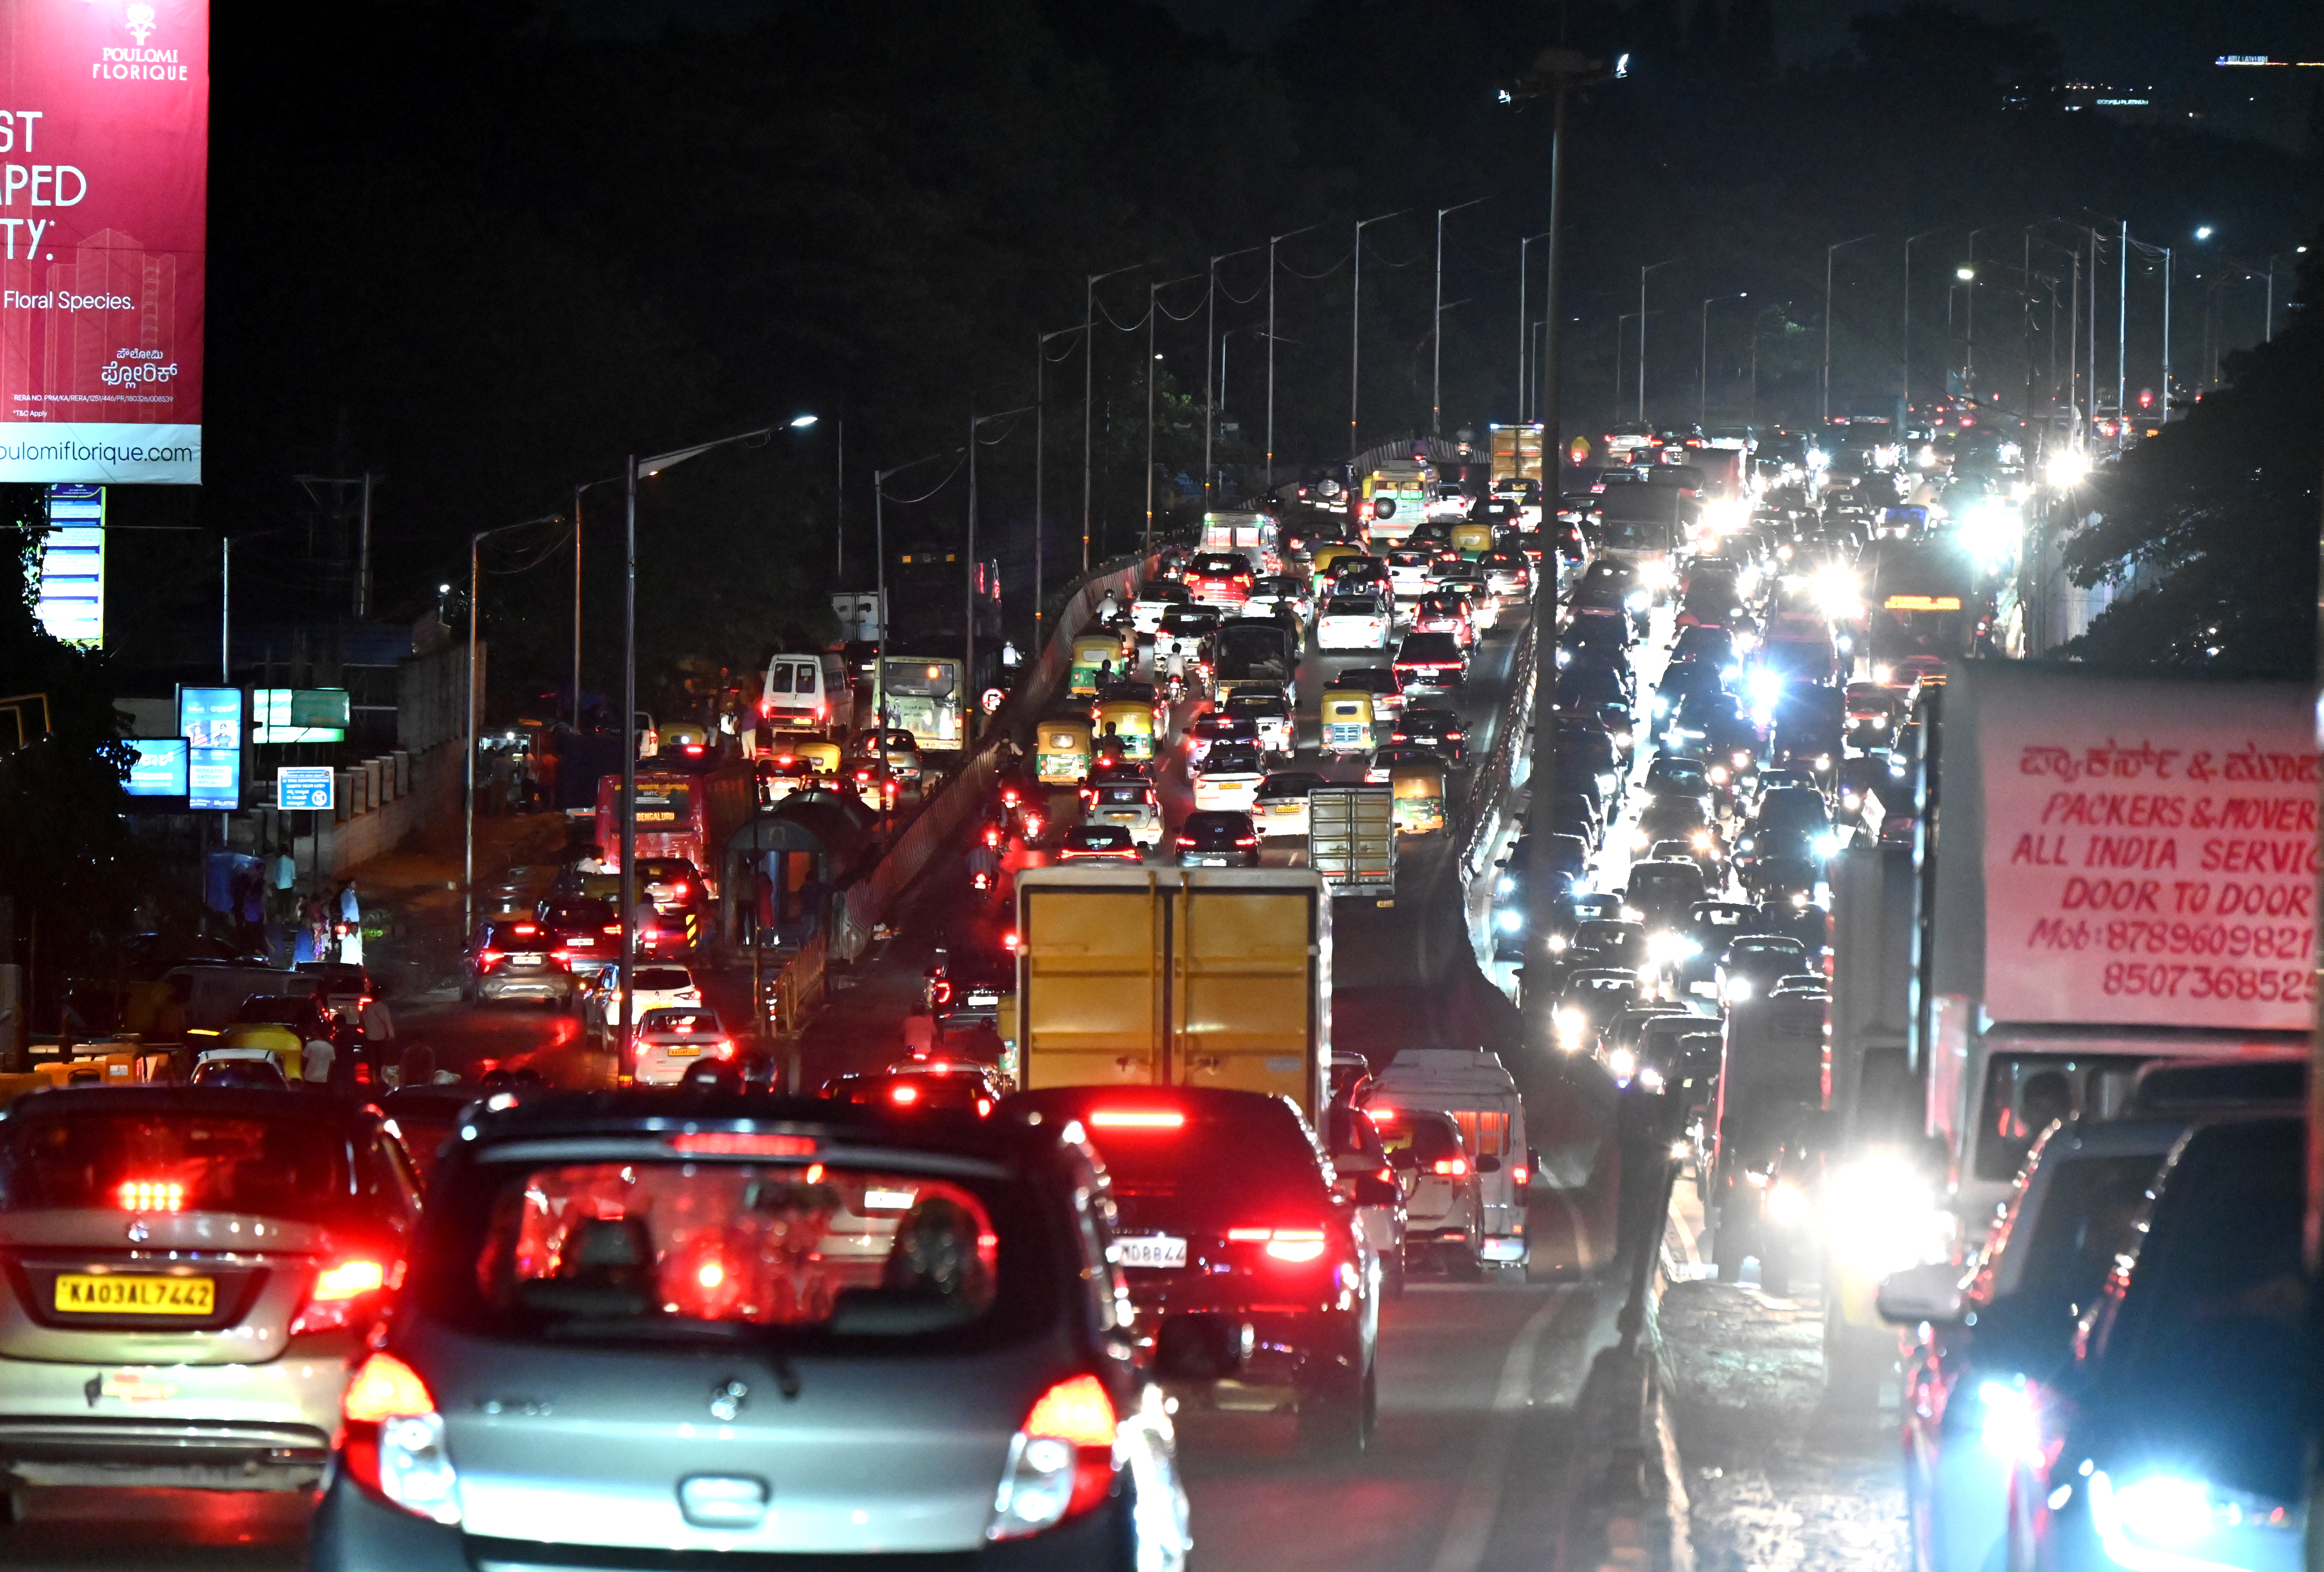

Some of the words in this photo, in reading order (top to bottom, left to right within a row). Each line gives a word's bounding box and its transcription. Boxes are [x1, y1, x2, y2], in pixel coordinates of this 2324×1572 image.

[103, 47, 177, 63] POULOMI
[93, 64, 187, 80] FLORIQUE
[0, 164, 86, 206] PED
[4, 290, 53, 308] Floral
[58, 291, 135, 312] Species.
[102, 361, 177, 388] ಫ್ಲೋರಿಕ್
[2187, 750, 2217, 783] &
[636, 812, 675, 821] BENGALURU
[2041, 791, 2185, 829] PACKERS
[2189, 797, 2219, 829] &
[2011, 833, 2067, 866] ALL
[2085, 834, 2177, 870] INDIA
[2061, 877, 2161, 913] DOOR
[2174, 881, 2211, 914] TO
[2216, 882, 2313, 918] DOOR
[2108, 921, 2313, 960] 8789609821
[70, 1282, 209, 1306] KA03AL7442
